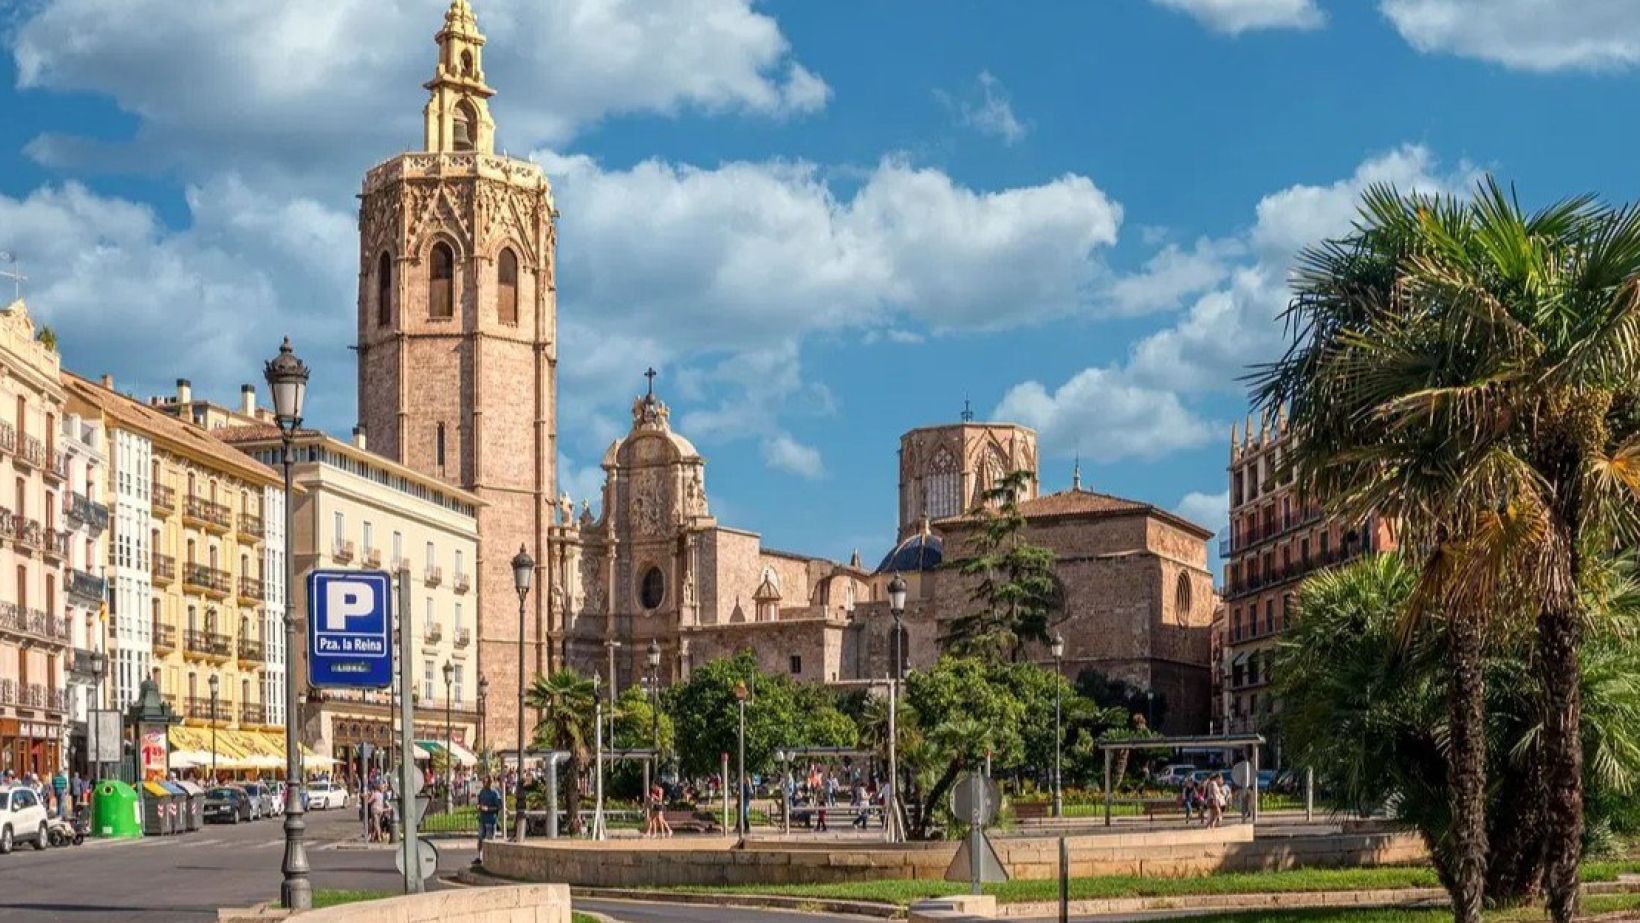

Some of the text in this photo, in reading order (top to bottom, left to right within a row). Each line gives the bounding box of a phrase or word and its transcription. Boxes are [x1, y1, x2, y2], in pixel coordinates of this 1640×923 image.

[327, 582, 374, 629] P
[320, 637, 382, 651] Pza. la Reina
